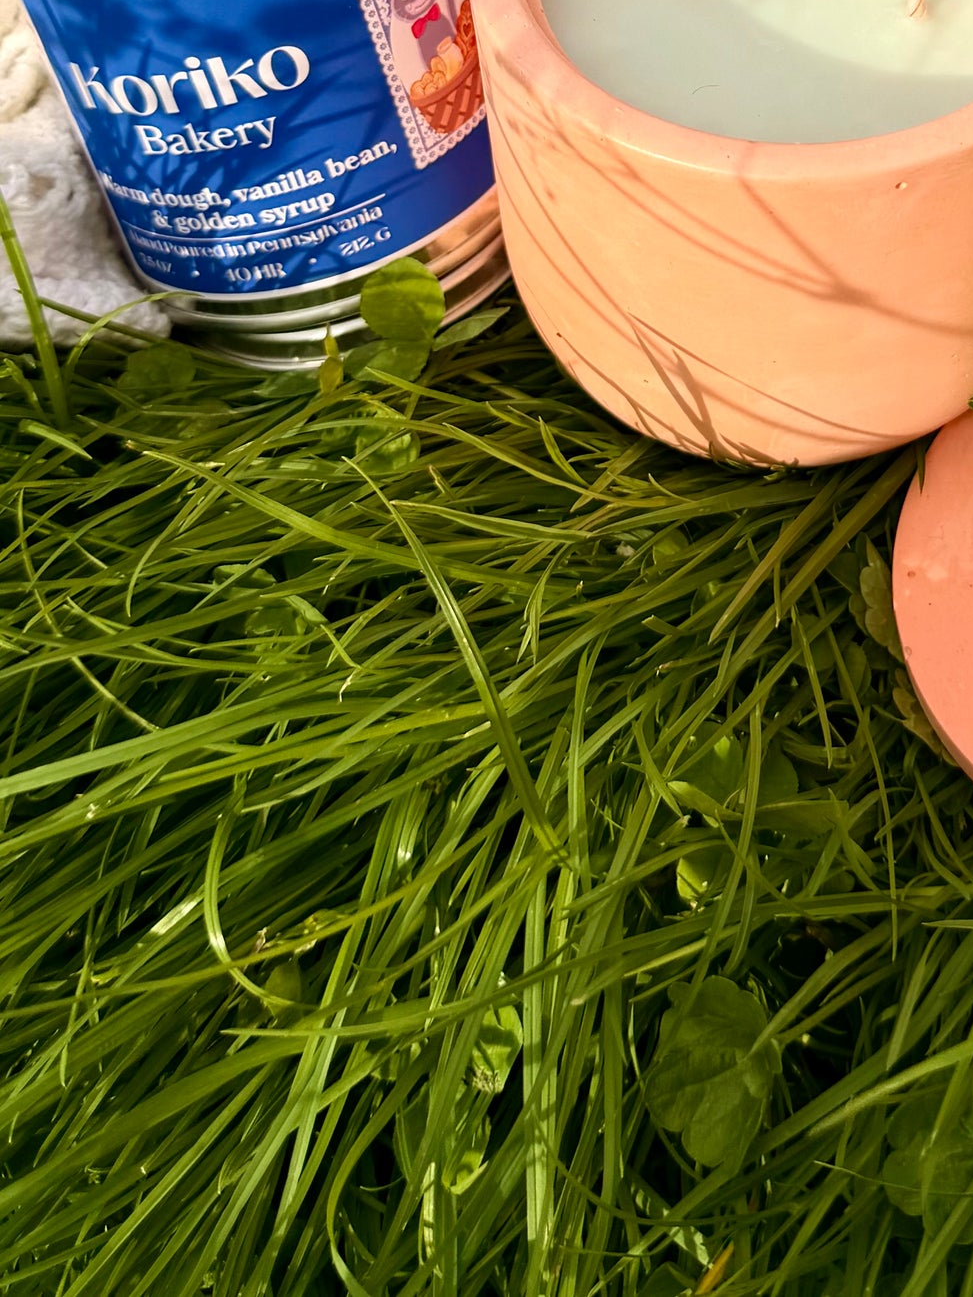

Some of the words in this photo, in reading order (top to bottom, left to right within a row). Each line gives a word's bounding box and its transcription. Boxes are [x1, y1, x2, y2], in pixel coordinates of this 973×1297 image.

[133, 116, 277, 156] Bakery
[150, 187, 232, 211] dough,
[231, 167, 325, 203] vanilla
[324, 139, 398, 179] bean,
[152, 209, 173, 230] &
[173, 212, 257, 235] golden
[258, 190, 336, 227] syrup
[246, 205, 384, 257] Pennsylvania
